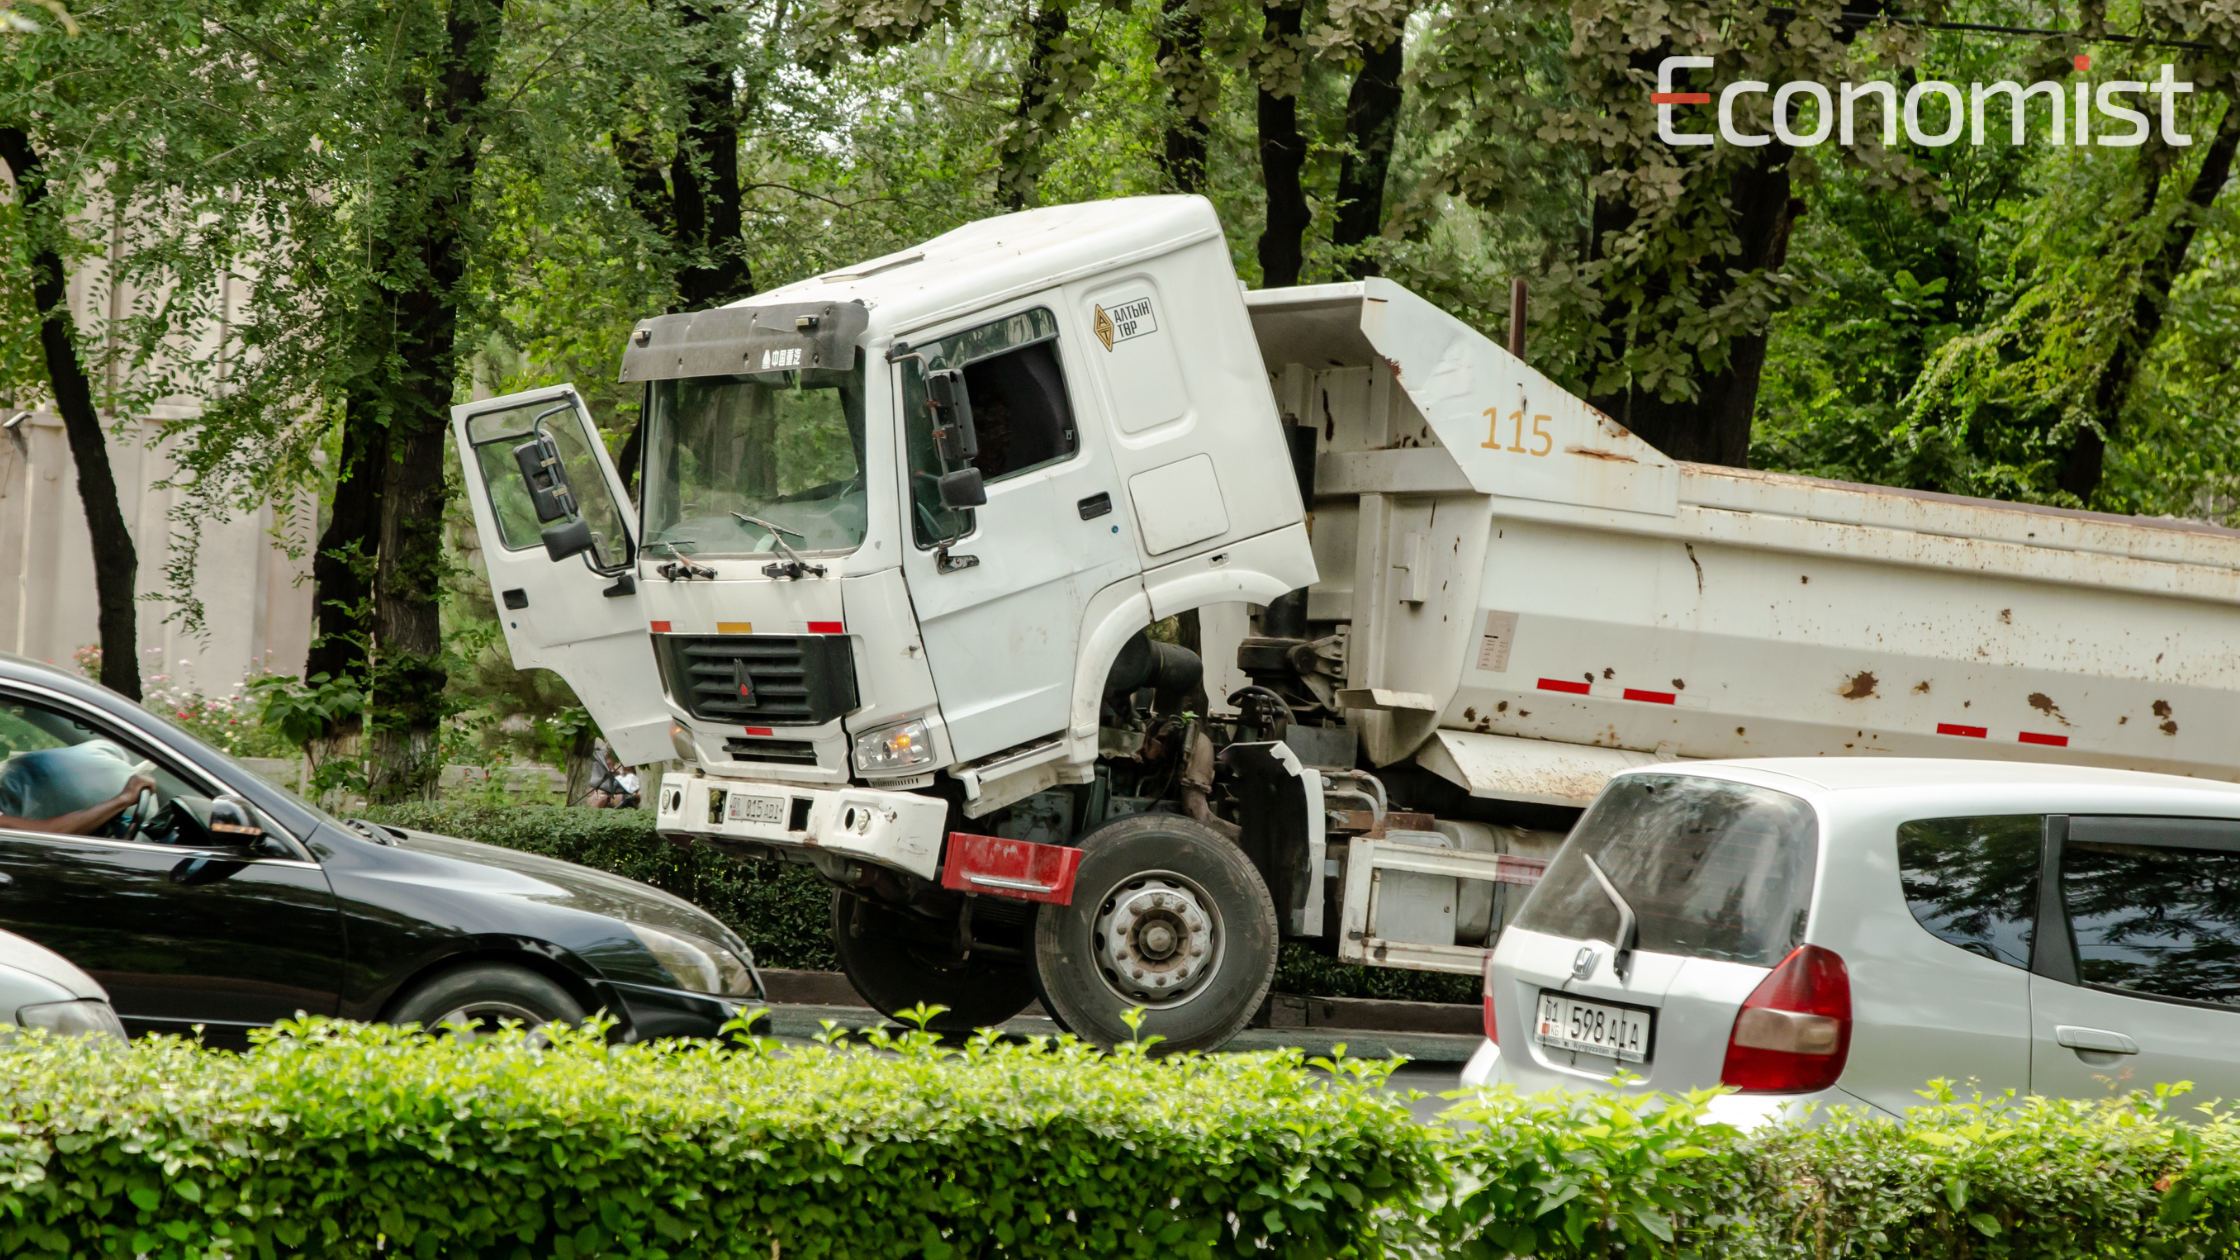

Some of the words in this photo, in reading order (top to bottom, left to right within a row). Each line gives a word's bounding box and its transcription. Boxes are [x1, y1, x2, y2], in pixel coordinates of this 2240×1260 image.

[1113, 301, 1150, 323] АЛТЫН
[1480, 407, 1553, 457] 115
[1551, 1024, 1560, 1037] KG
[1570, 1006, 1605, 1043] 598
[1608, 1018, 1639, 1051] AIA
[1573, 1043, 1610, 1054] Kyrgyzstan
